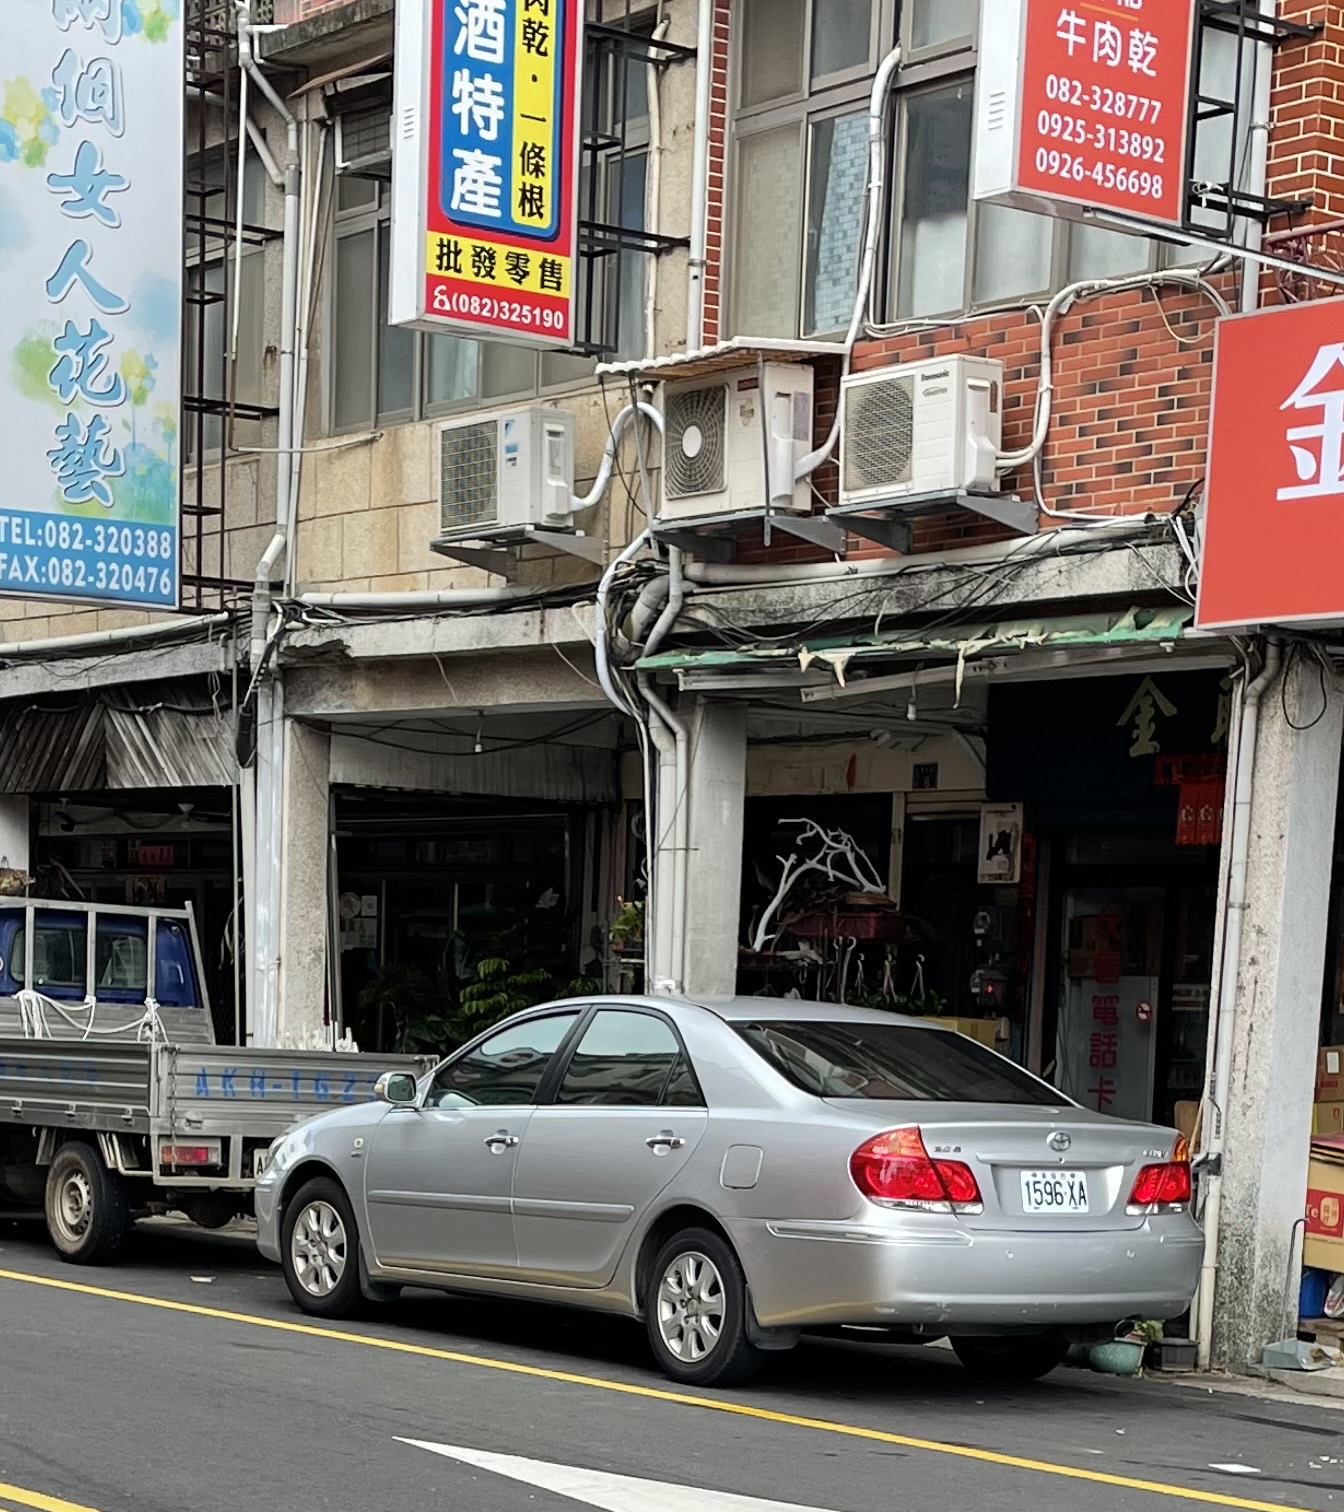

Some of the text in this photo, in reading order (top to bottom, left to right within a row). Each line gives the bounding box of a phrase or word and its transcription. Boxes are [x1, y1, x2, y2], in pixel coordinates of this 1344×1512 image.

[1057, 8, 1159, 77] 牛肉乾
[450, 0, 506, 218] 酒特產
[1045, 74, 1162, 125] 082-328777
[1037, 110, 1165, 164] 0925-313892
[1035, 147, 1163, 199] 0926-456698
[436, 237, 563, 292] 批發零售
[451, 291, 564, 330] (082)325190
